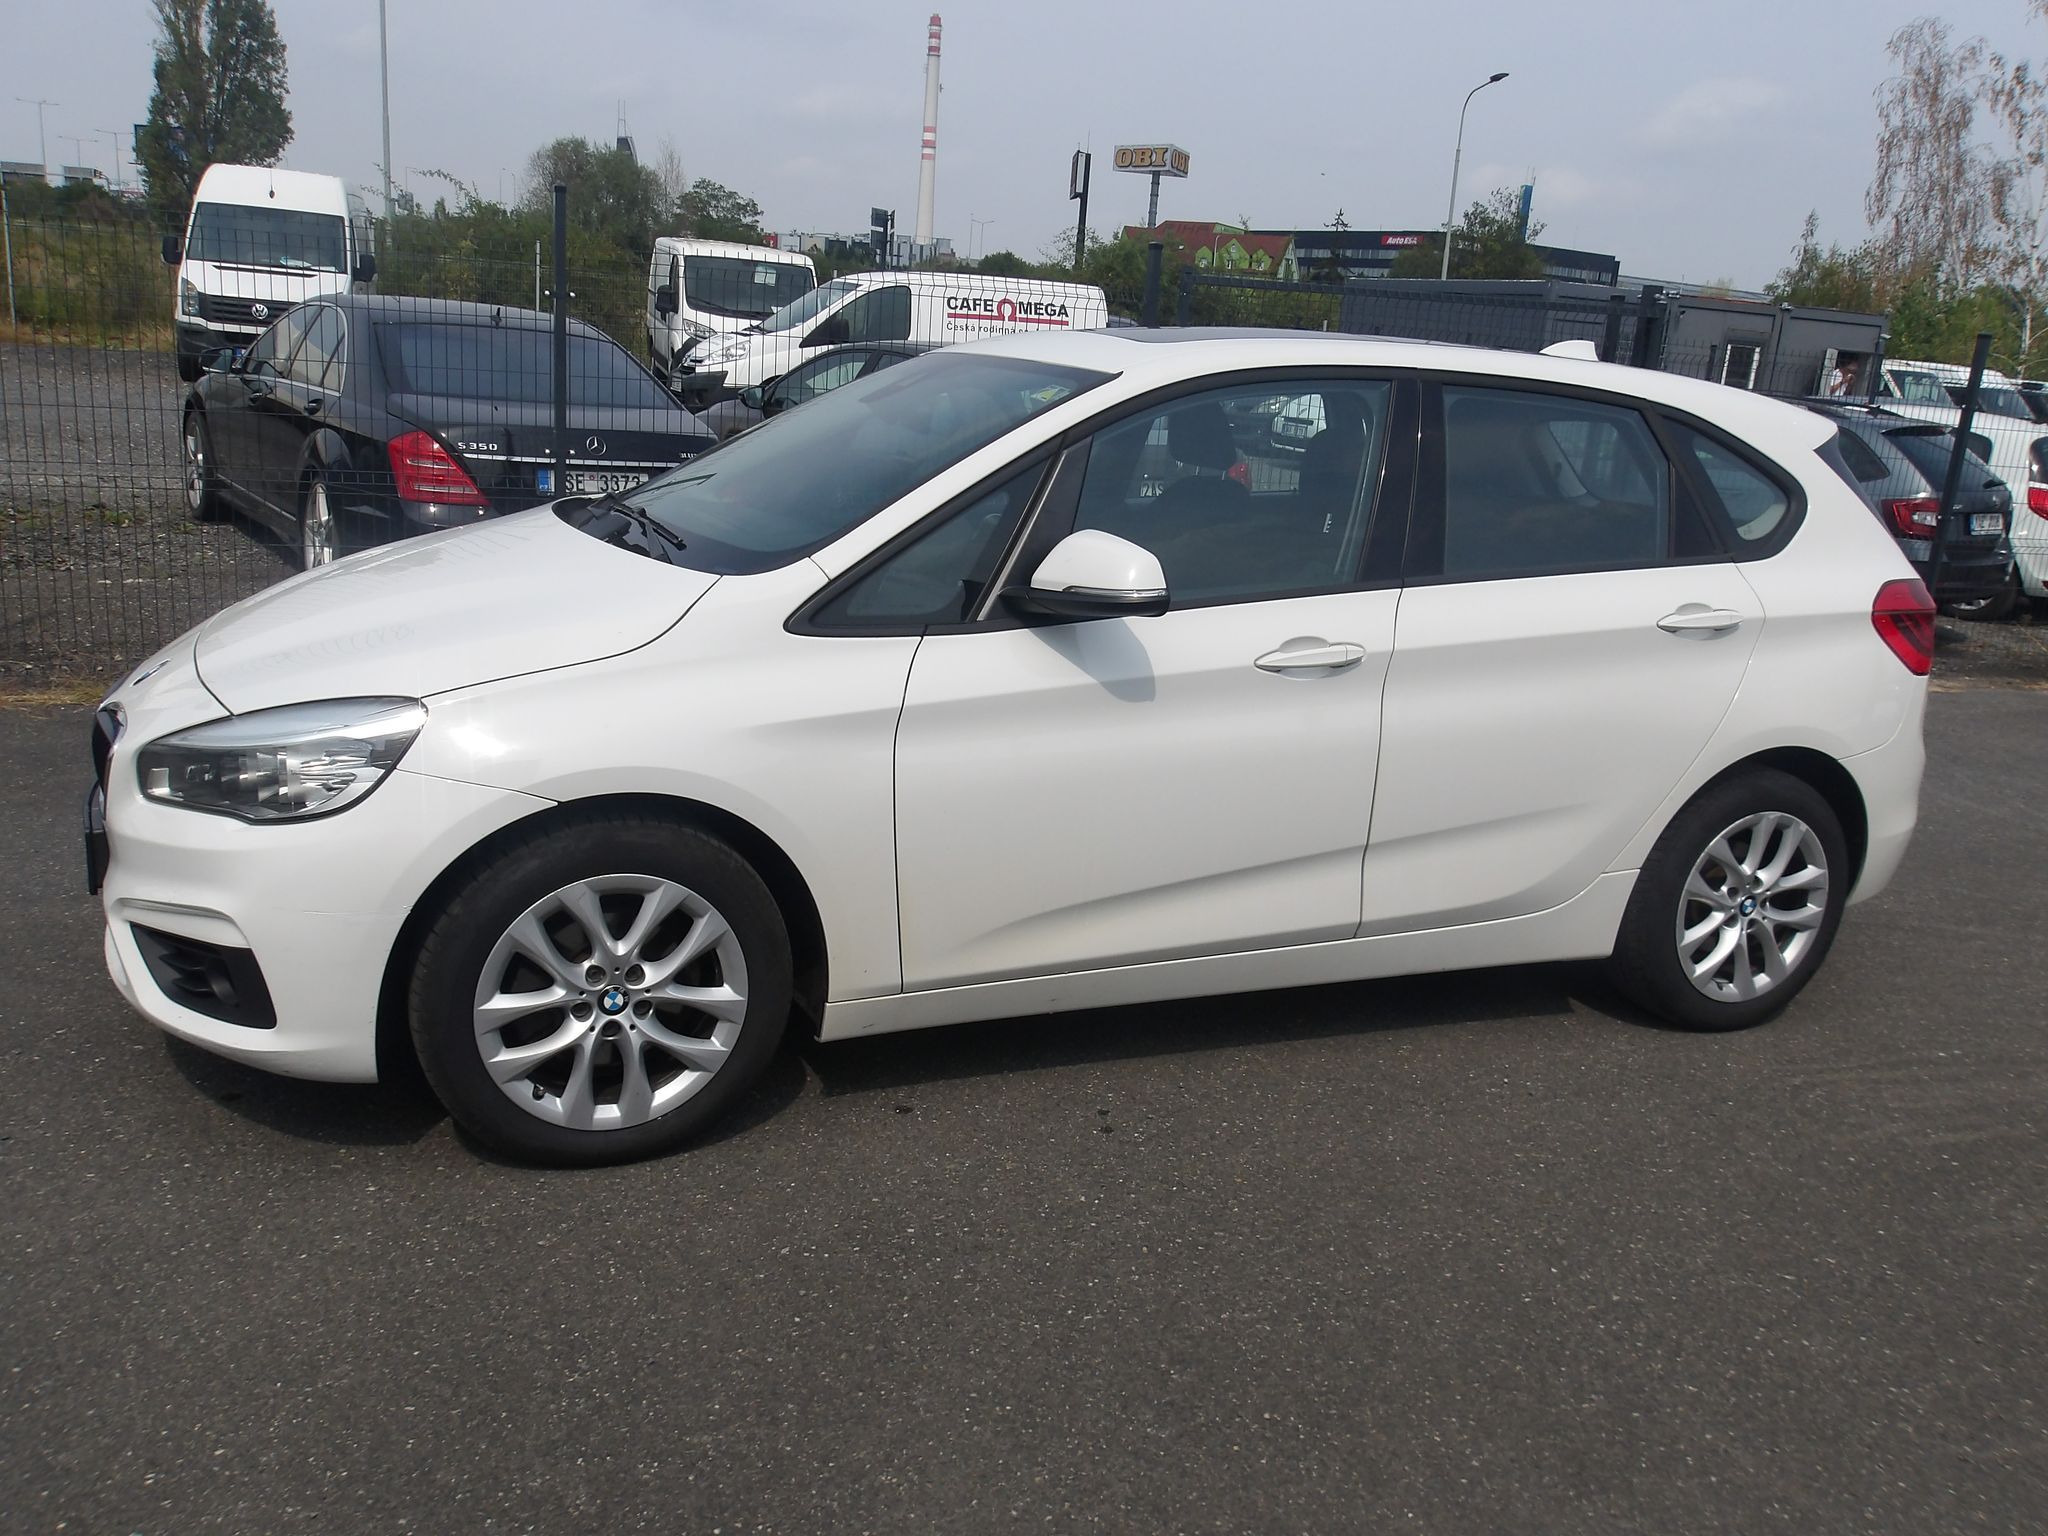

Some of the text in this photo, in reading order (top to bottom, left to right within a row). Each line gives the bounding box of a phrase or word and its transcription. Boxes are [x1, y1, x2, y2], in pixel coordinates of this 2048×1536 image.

[1115, 148, 1168, 167] OBI
[1387, 236, 1417, 245] Auto ESA
[946, 297, 994, 312] CAFE
[946, 321, 976, 332] Česká
[469, 442, 498, 450] 350
[565, 473, 585, 492] SE
